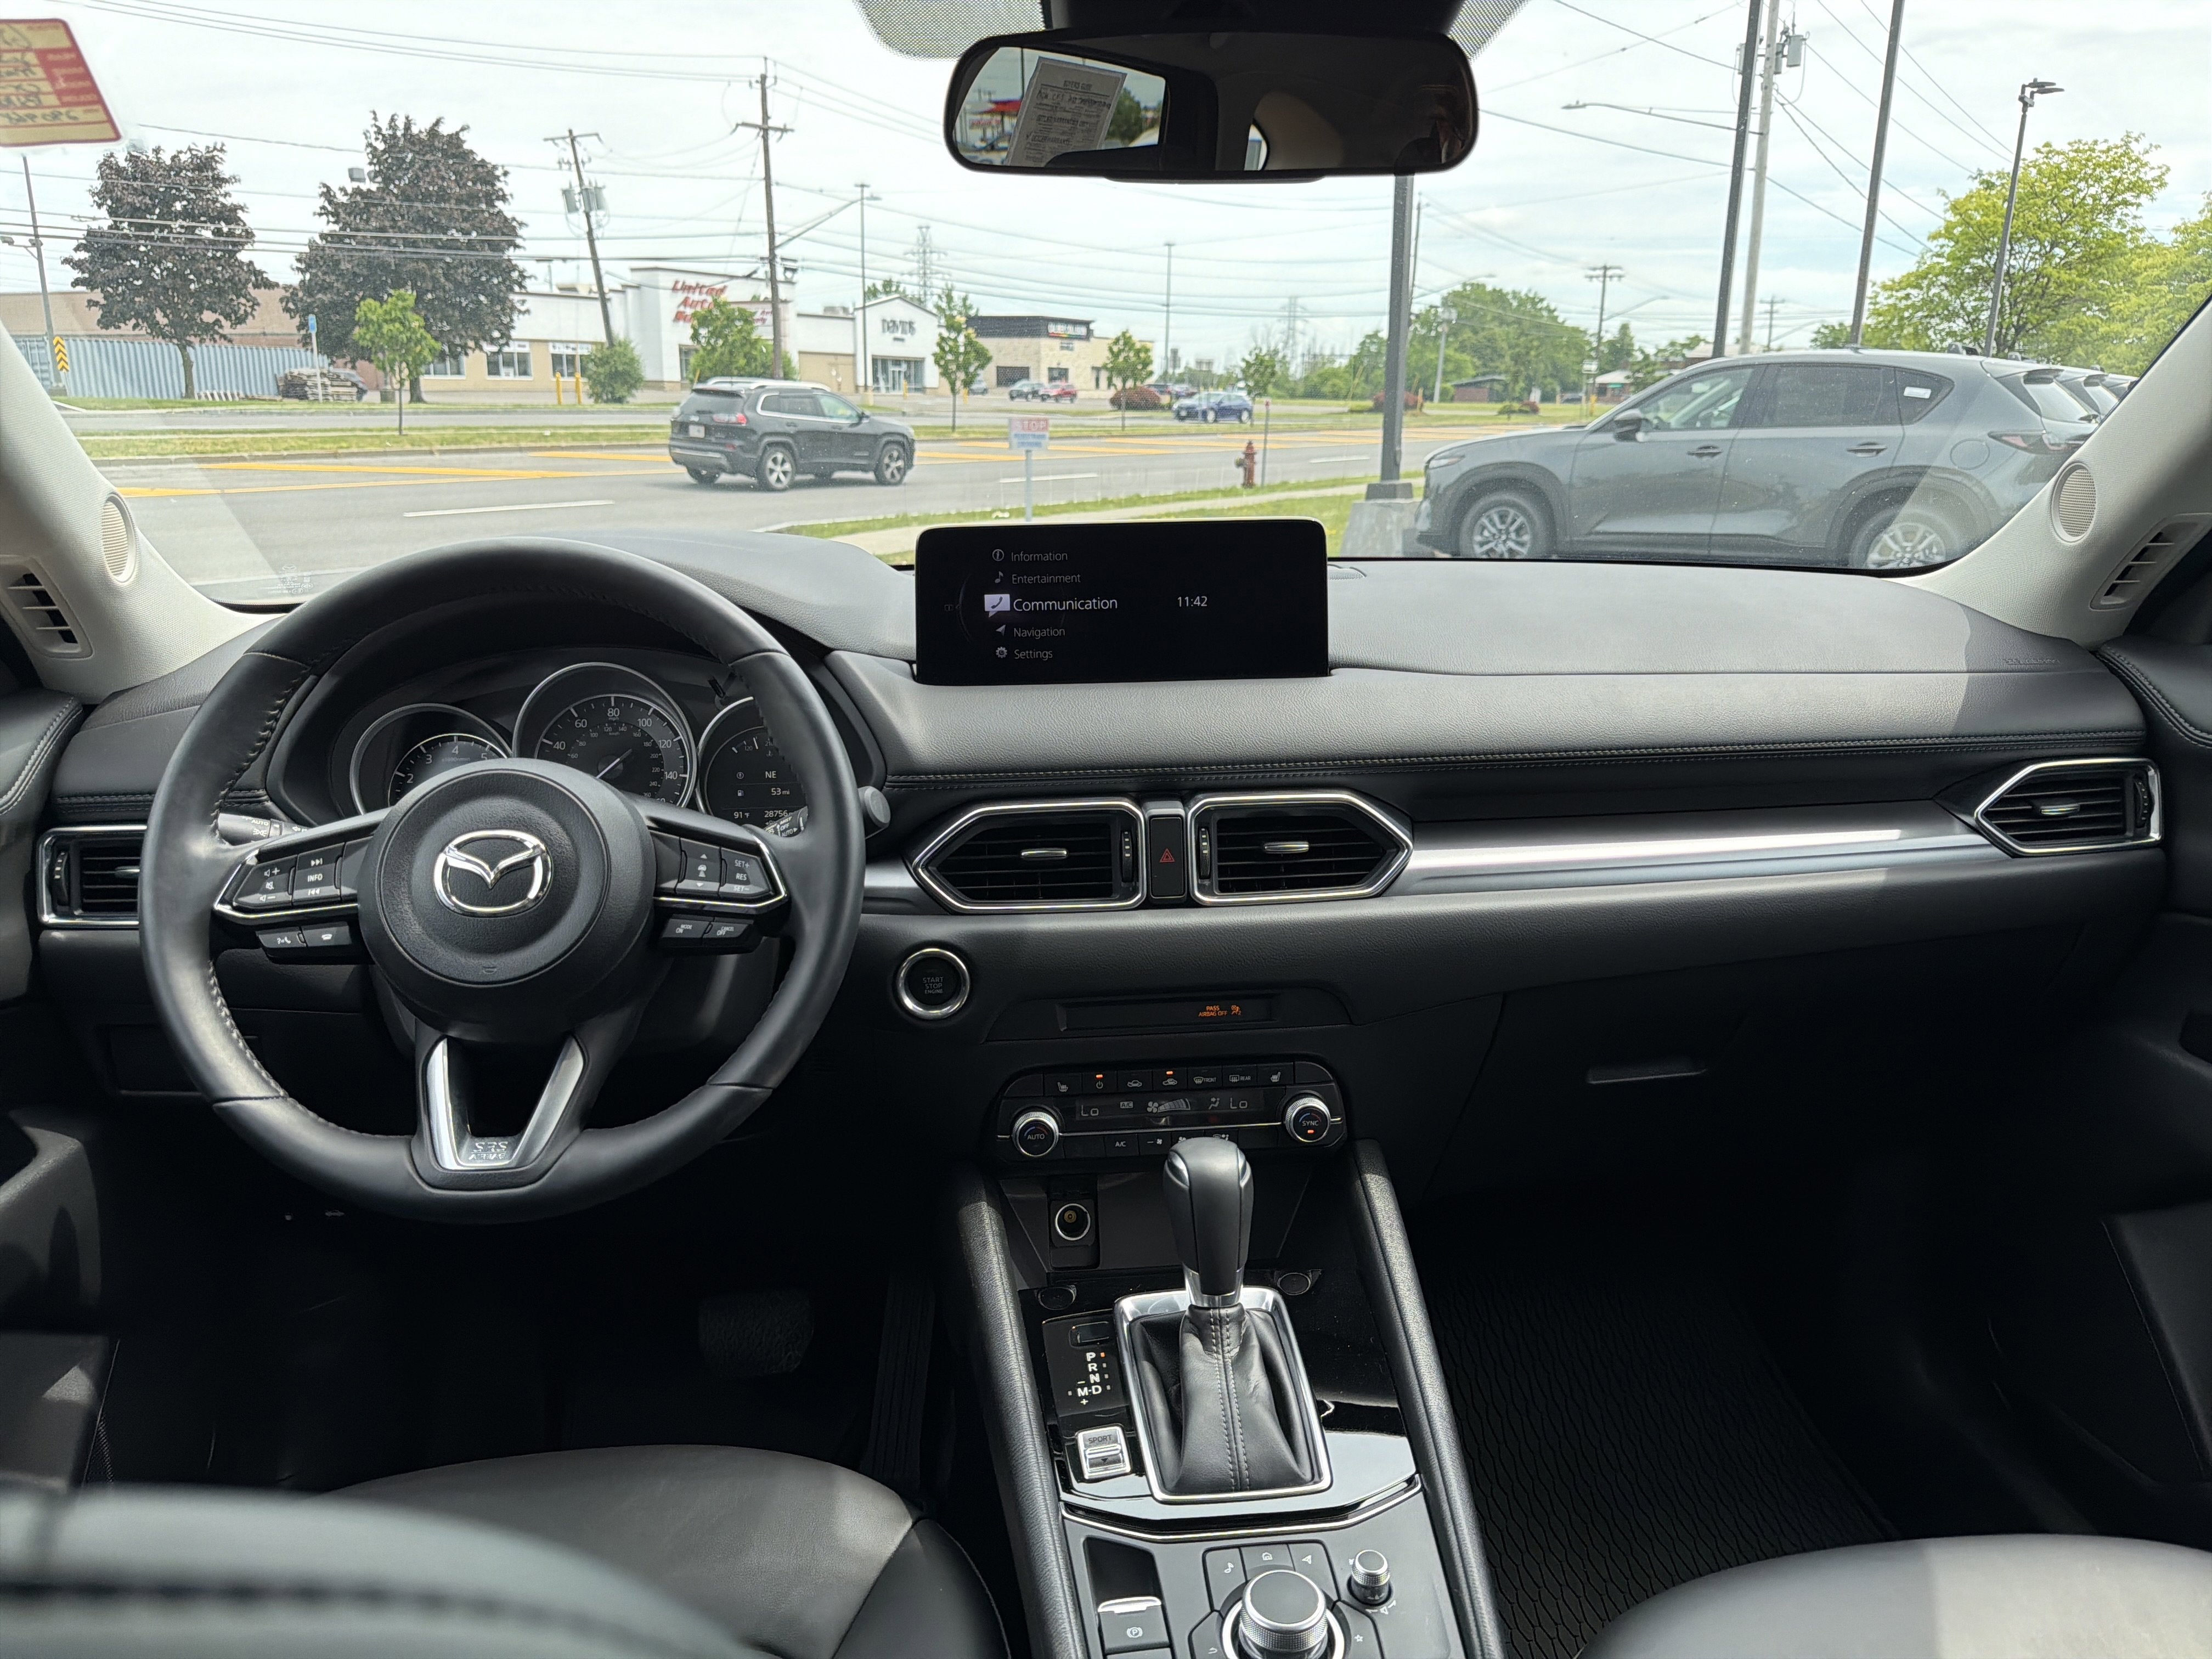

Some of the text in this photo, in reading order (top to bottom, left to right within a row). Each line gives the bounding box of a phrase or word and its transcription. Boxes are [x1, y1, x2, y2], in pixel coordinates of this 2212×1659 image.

[672, 279, 728, 296] United
[1011, 551, 1068, 562] Information
[1012, 573, 1081, 584] Entertainment
[1013, 597, 1118, 611] Communication
[1177, 596, 1207, 607] 11:42
[1014, 627, 1065, 639] Navigation
[1014, 649, 1053, 661] Settings
[607, 708, 620, 716] 80
[574, 719, 588, 727] 60
[637, 718, 652, 727] 100
[553, 741, 566, 750] 40
[658, 740, 672, 748] 120
[452, 745, 459, 754] 4
[425, 754, 432, 764] 3
[407, 774, 414, 783] 2
[664, 771, 678, 780] 140
[764, 810, 788, 818] 28756
[781, 829, 793, 837] AUTO
[307, 873, 323, 882] INFO
[473, 1141, 508, 1152] SRS
[1086, 1352, 1096, 1361] P
[1088, 1363, 1098, 1372] R
[1090, 1373, 1101, 1383] N
[1088, 1434, 1112, 1444] SPORT
